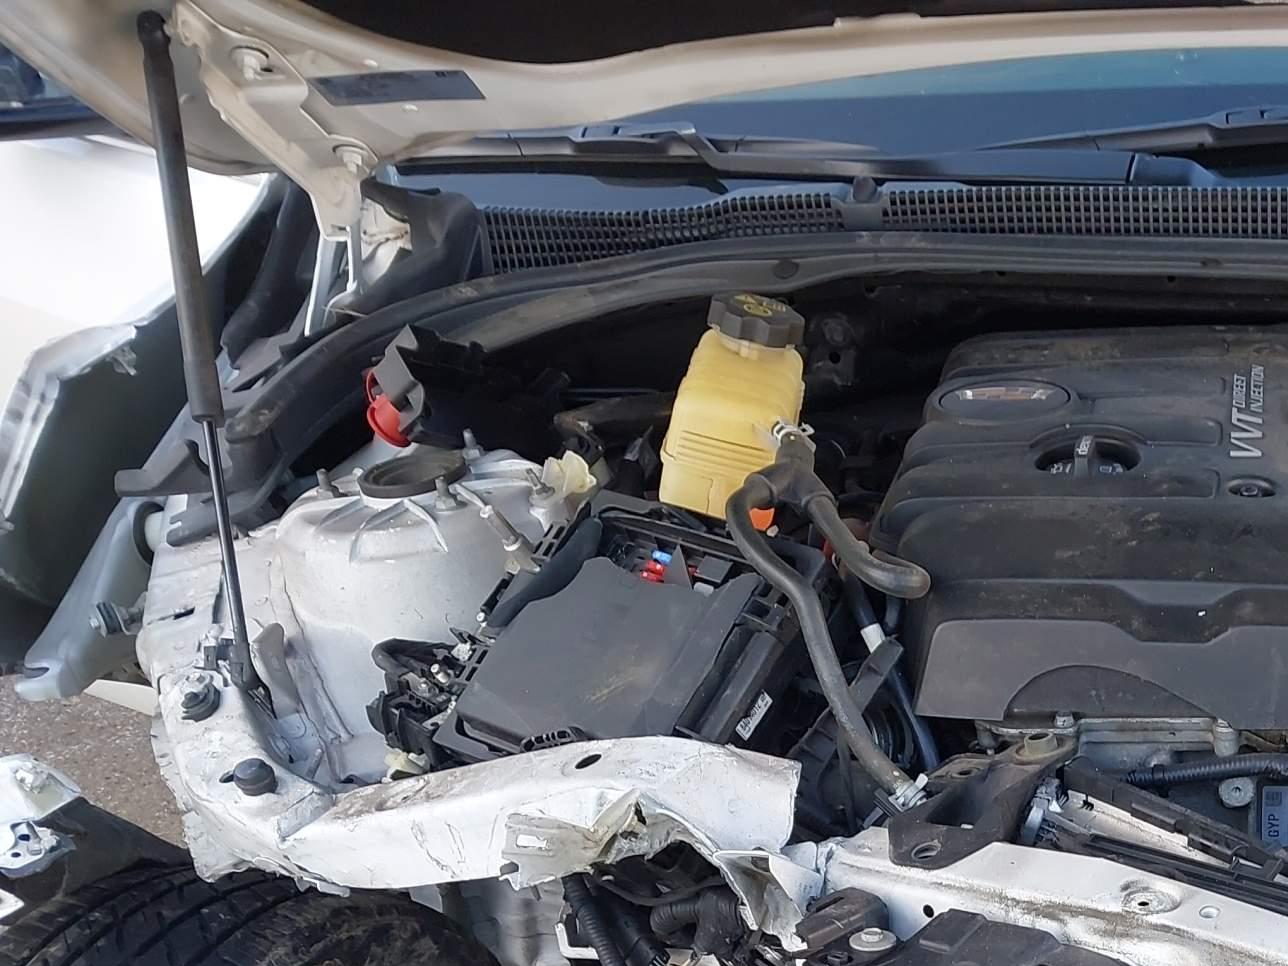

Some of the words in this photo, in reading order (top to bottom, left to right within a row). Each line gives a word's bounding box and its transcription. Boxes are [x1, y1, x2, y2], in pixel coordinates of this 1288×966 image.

[1232, 373, 1246, 409] DIRECT
[1250, 363, 1264, 413] INJECTION
[1229, 406, 1263, 457] VVT
[1267, 813, 1280, 838] GYP
